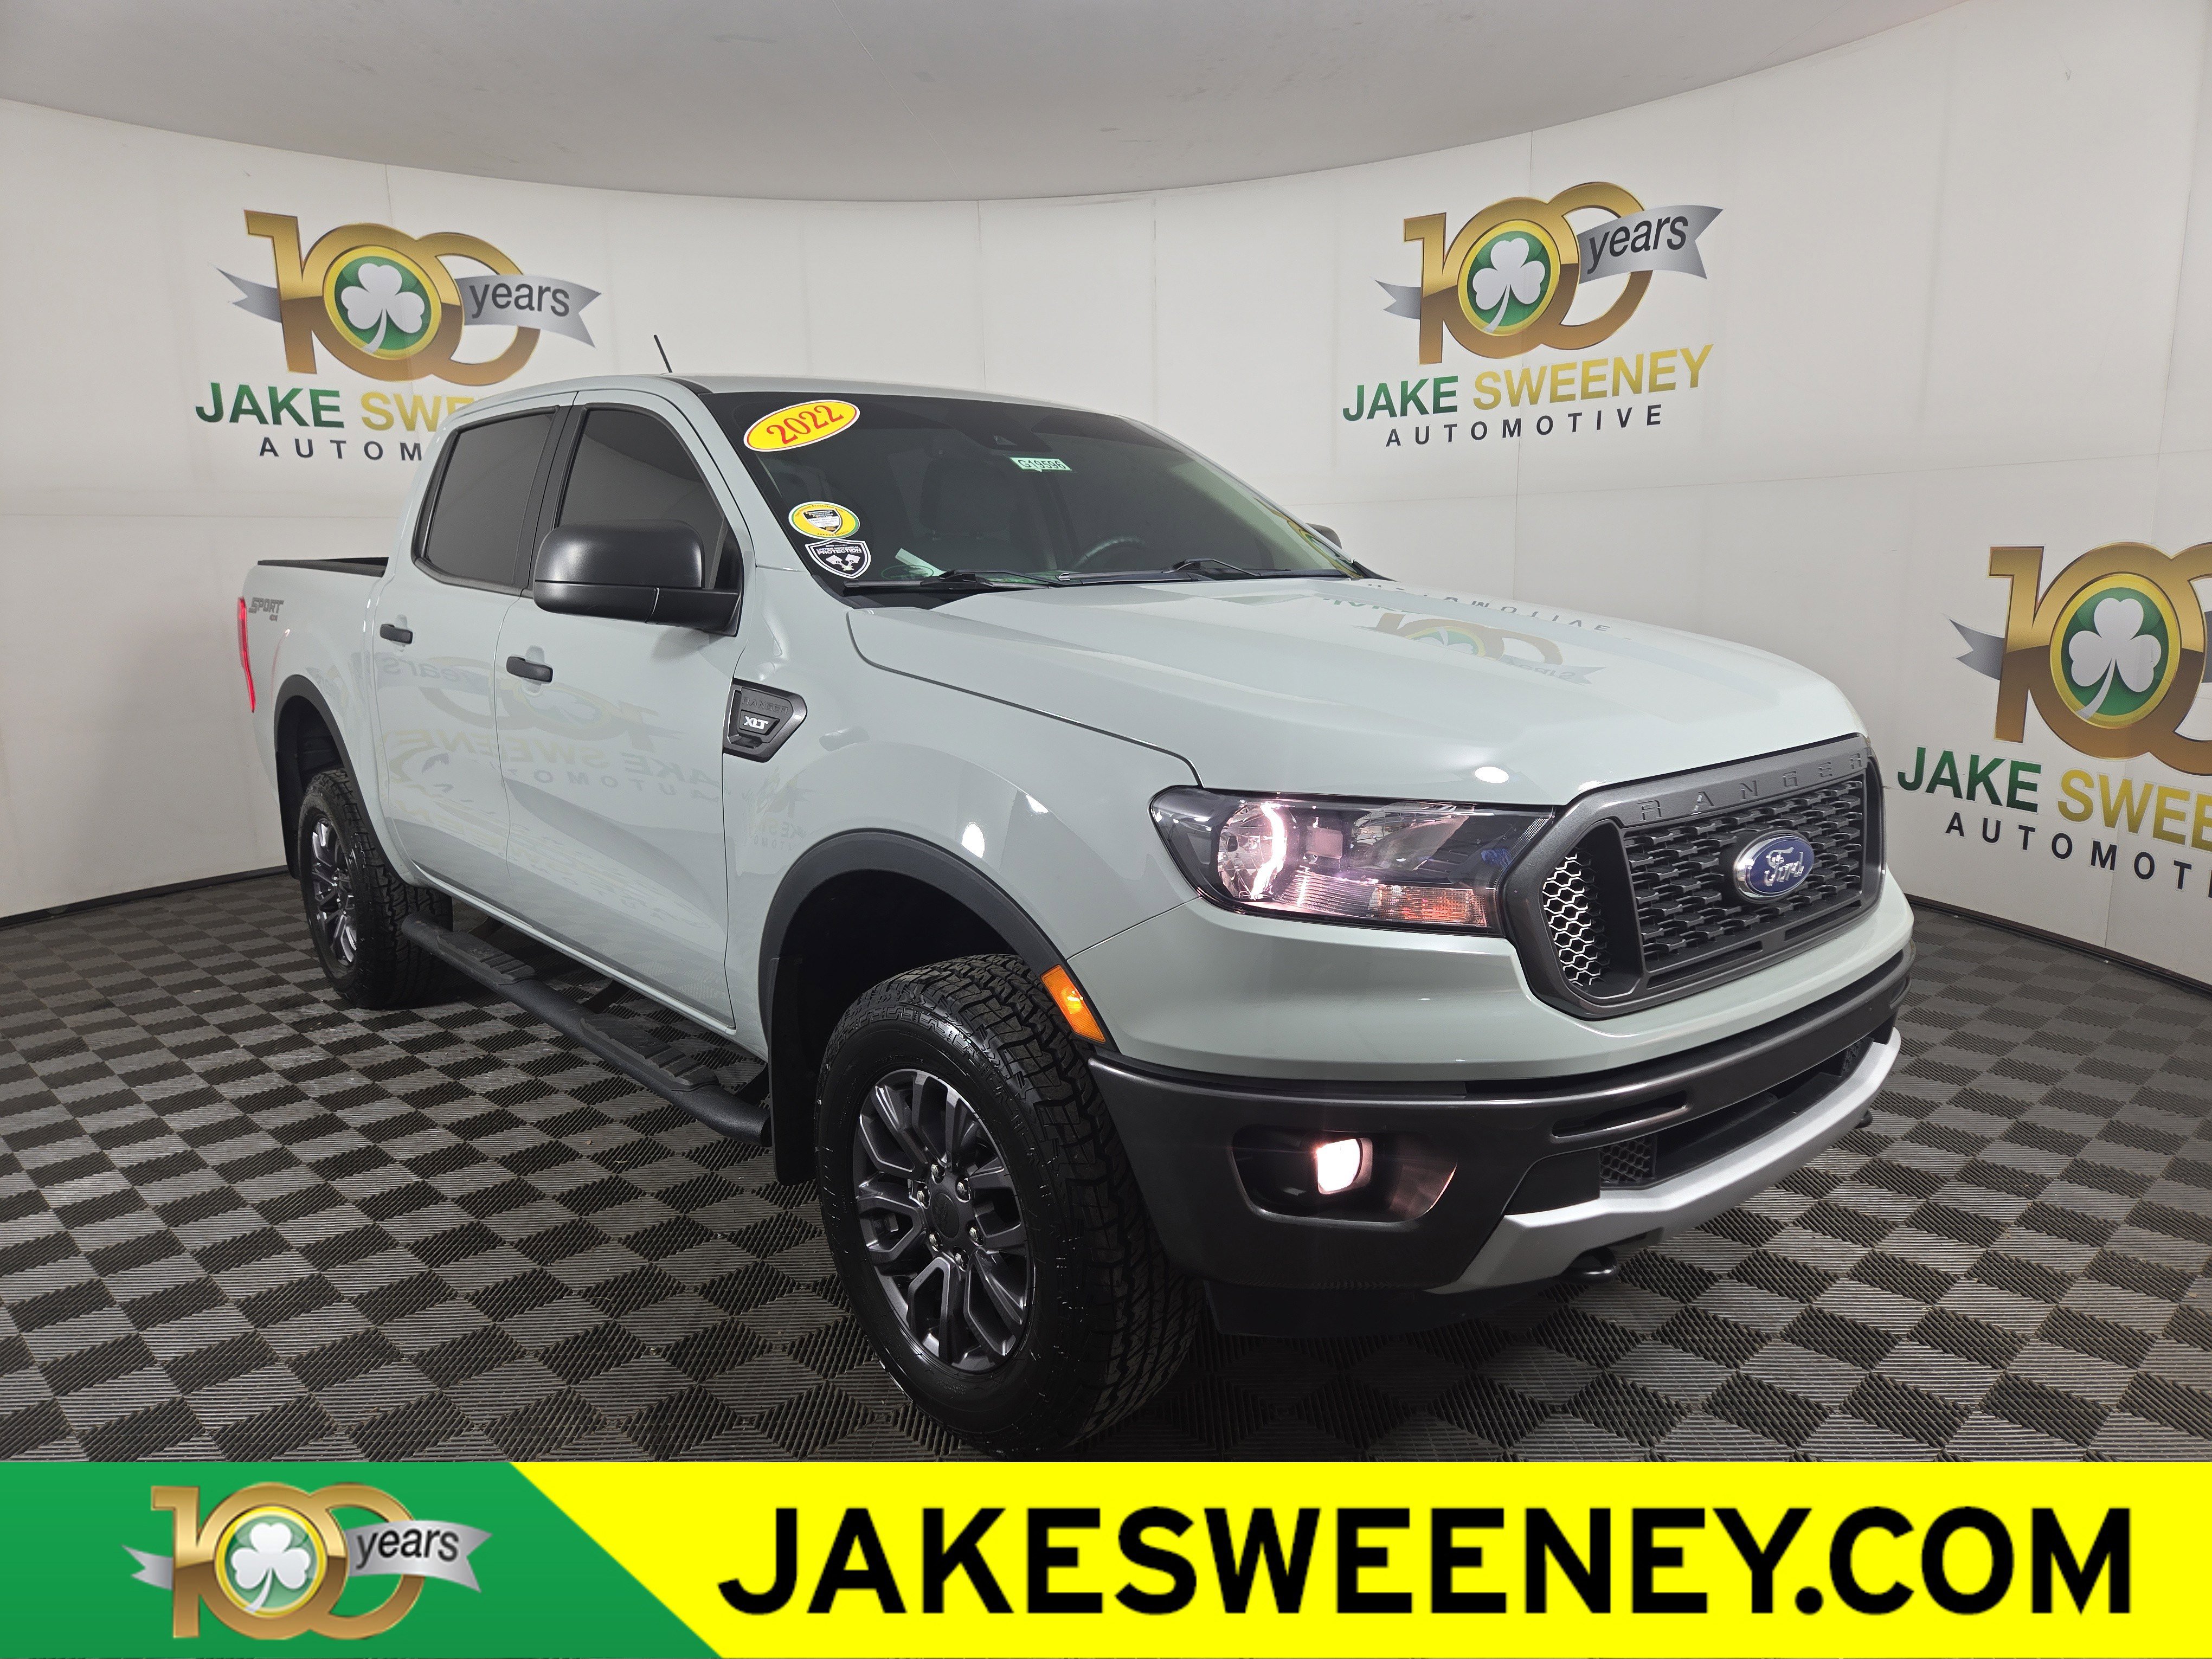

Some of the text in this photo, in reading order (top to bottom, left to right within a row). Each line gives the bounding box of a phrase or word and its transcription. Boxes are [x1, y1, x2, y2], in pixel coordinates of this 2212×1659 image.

[1404, 182, 1688, 365] 100 years
[244, 209, 570, 386] 100 years
[1343, 344, 1714, 421] JAKE SWEENEY
[196, 382, 484, 432] JAKE SW
[766, 405, 844, 444] 2022
[1386, 404, 1662, 447] AUTOMOTIVE
[259, 437, 422, 461] AUTOM
[1018, 460, 1066, 469] G19596
[248, 597, 284, 613] SPORT
[742, 697, 788, 714] RANGER
[743, 716, 769, 730] XLT
[1638, 753, 1862, 821] RANGER
[1898, 747, 2042, 813] JAKE
[1764, 846, 1804, 886] Ford
